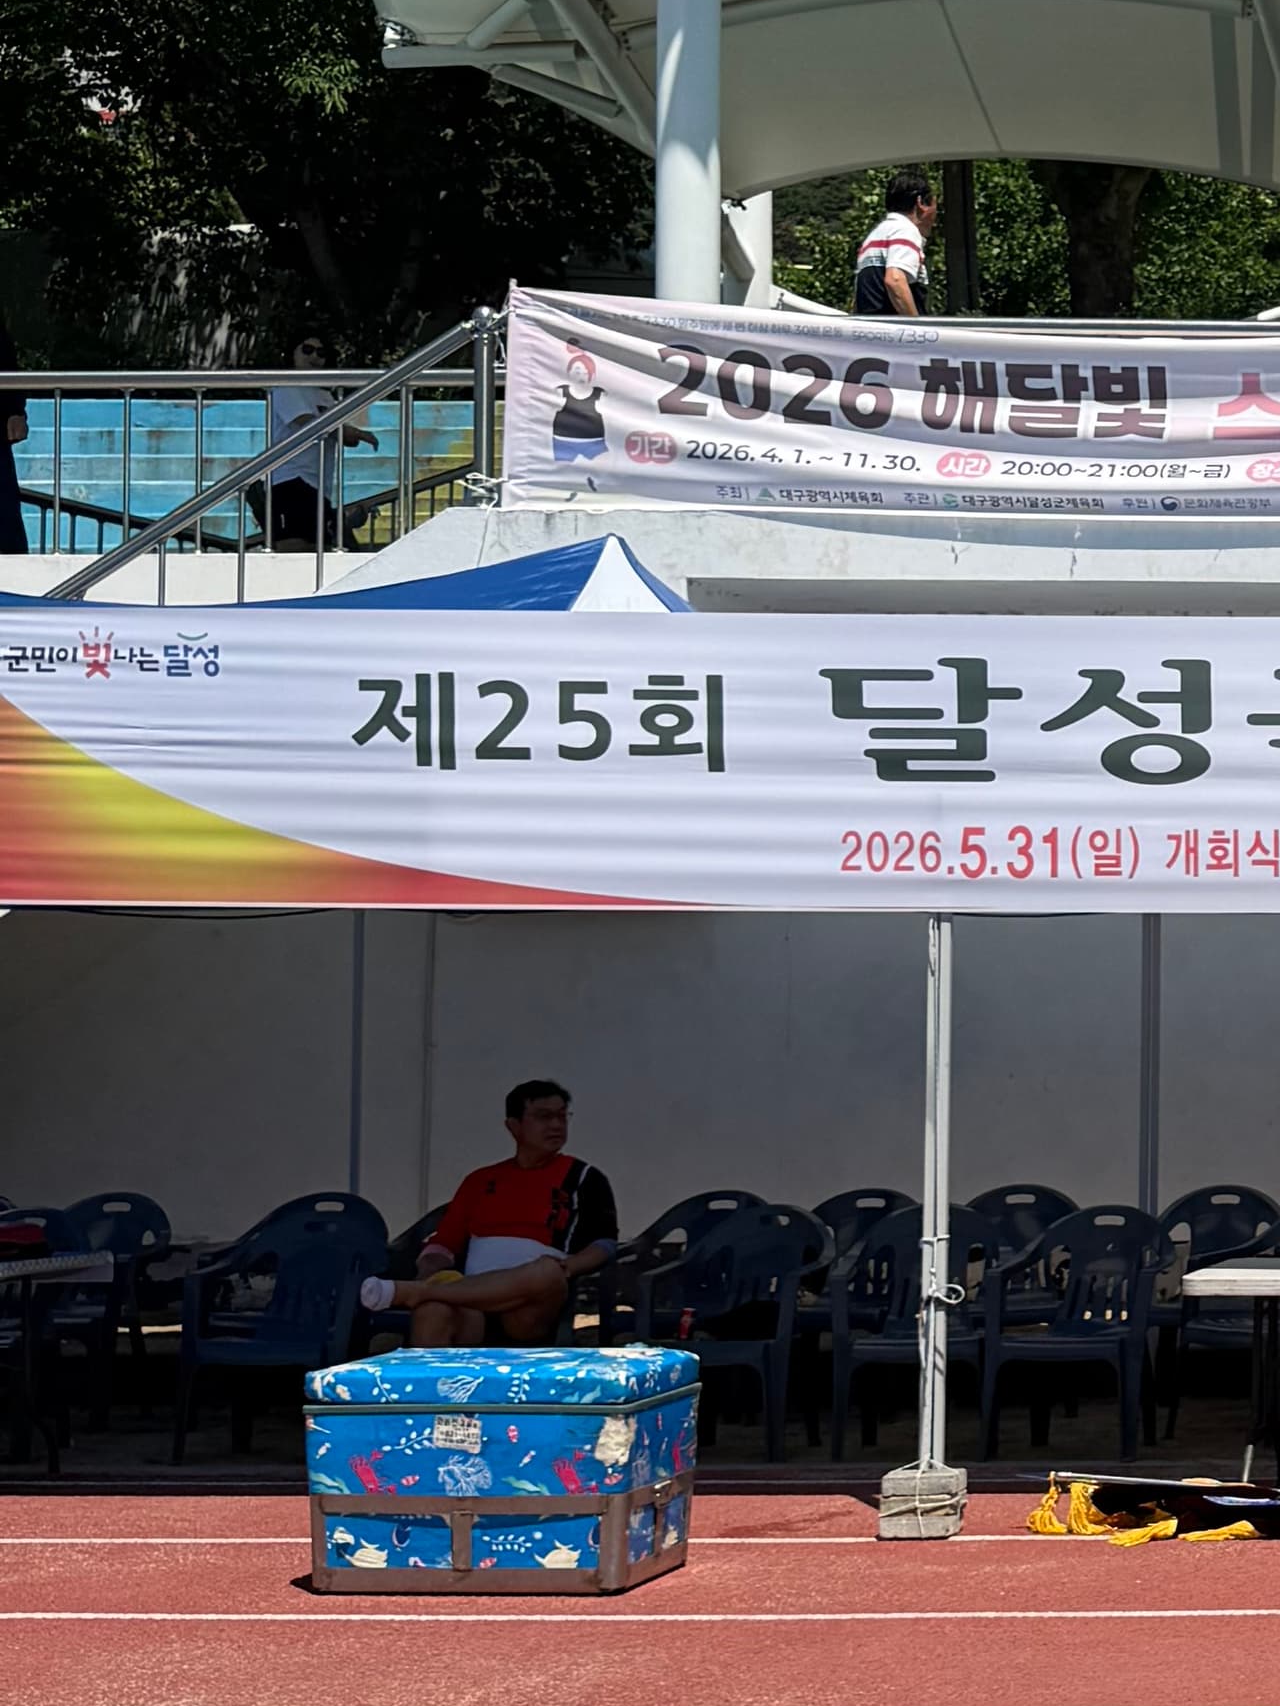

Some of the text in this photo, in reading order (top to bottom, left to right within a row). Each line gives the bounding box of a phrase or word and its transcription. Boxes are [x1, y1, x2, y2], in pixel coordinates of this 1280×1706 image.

[658, 345, 895, 430] 2026
[921, 358, 1167, 440] 해달빛
[629, 434, 672, 460] 기간
[945, 456, 988, 477] 시간
[779, 489, 884, 504] 대구광역시체육회
[962, 495, 1105, 510] 대구광역시달성군체육회
[2, 638, 220, 679] 군민이 빛나는 달성
[352, 671, 727, 771] 제25회
[839, 824, 1141, 881] 2026.5.31(일)
